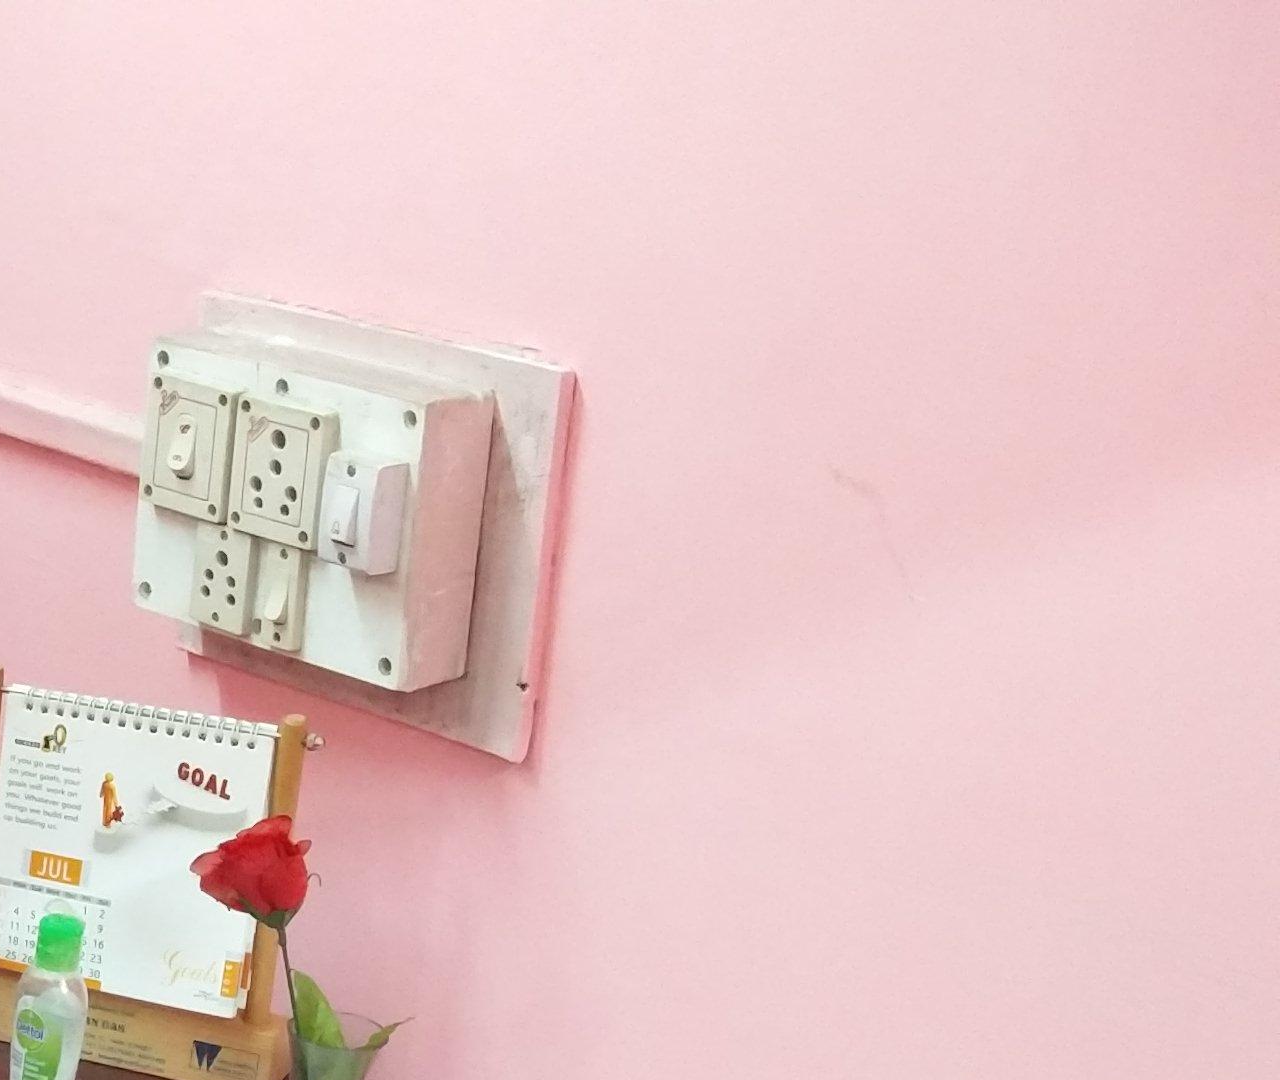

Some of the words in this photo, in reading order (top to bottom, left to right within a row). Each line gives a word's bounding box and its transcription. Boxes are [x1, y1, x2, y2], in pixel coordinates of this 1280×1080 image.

[177, 762, 231, 801] GOAL
[36, 856, 72, 882] JUL
[13, 906, 19, 916] 4
[31, 910, 36, 919] 5
[98, 909, 105, 919] 2
[10, 921, 20, 931] 11
[27, 925, 38, 935] 12
[97, 924, 103, 934] 9
[8, 935, 19, 946] 18
[25, 939, 35, 949] 19
[93, 938, 104, 949] 16
[4, 949, 17, 960] 25
[21, 953, 33, 963] 26
[89, 953, 102, 964] 23
[88, 968, 101, 979] 30
